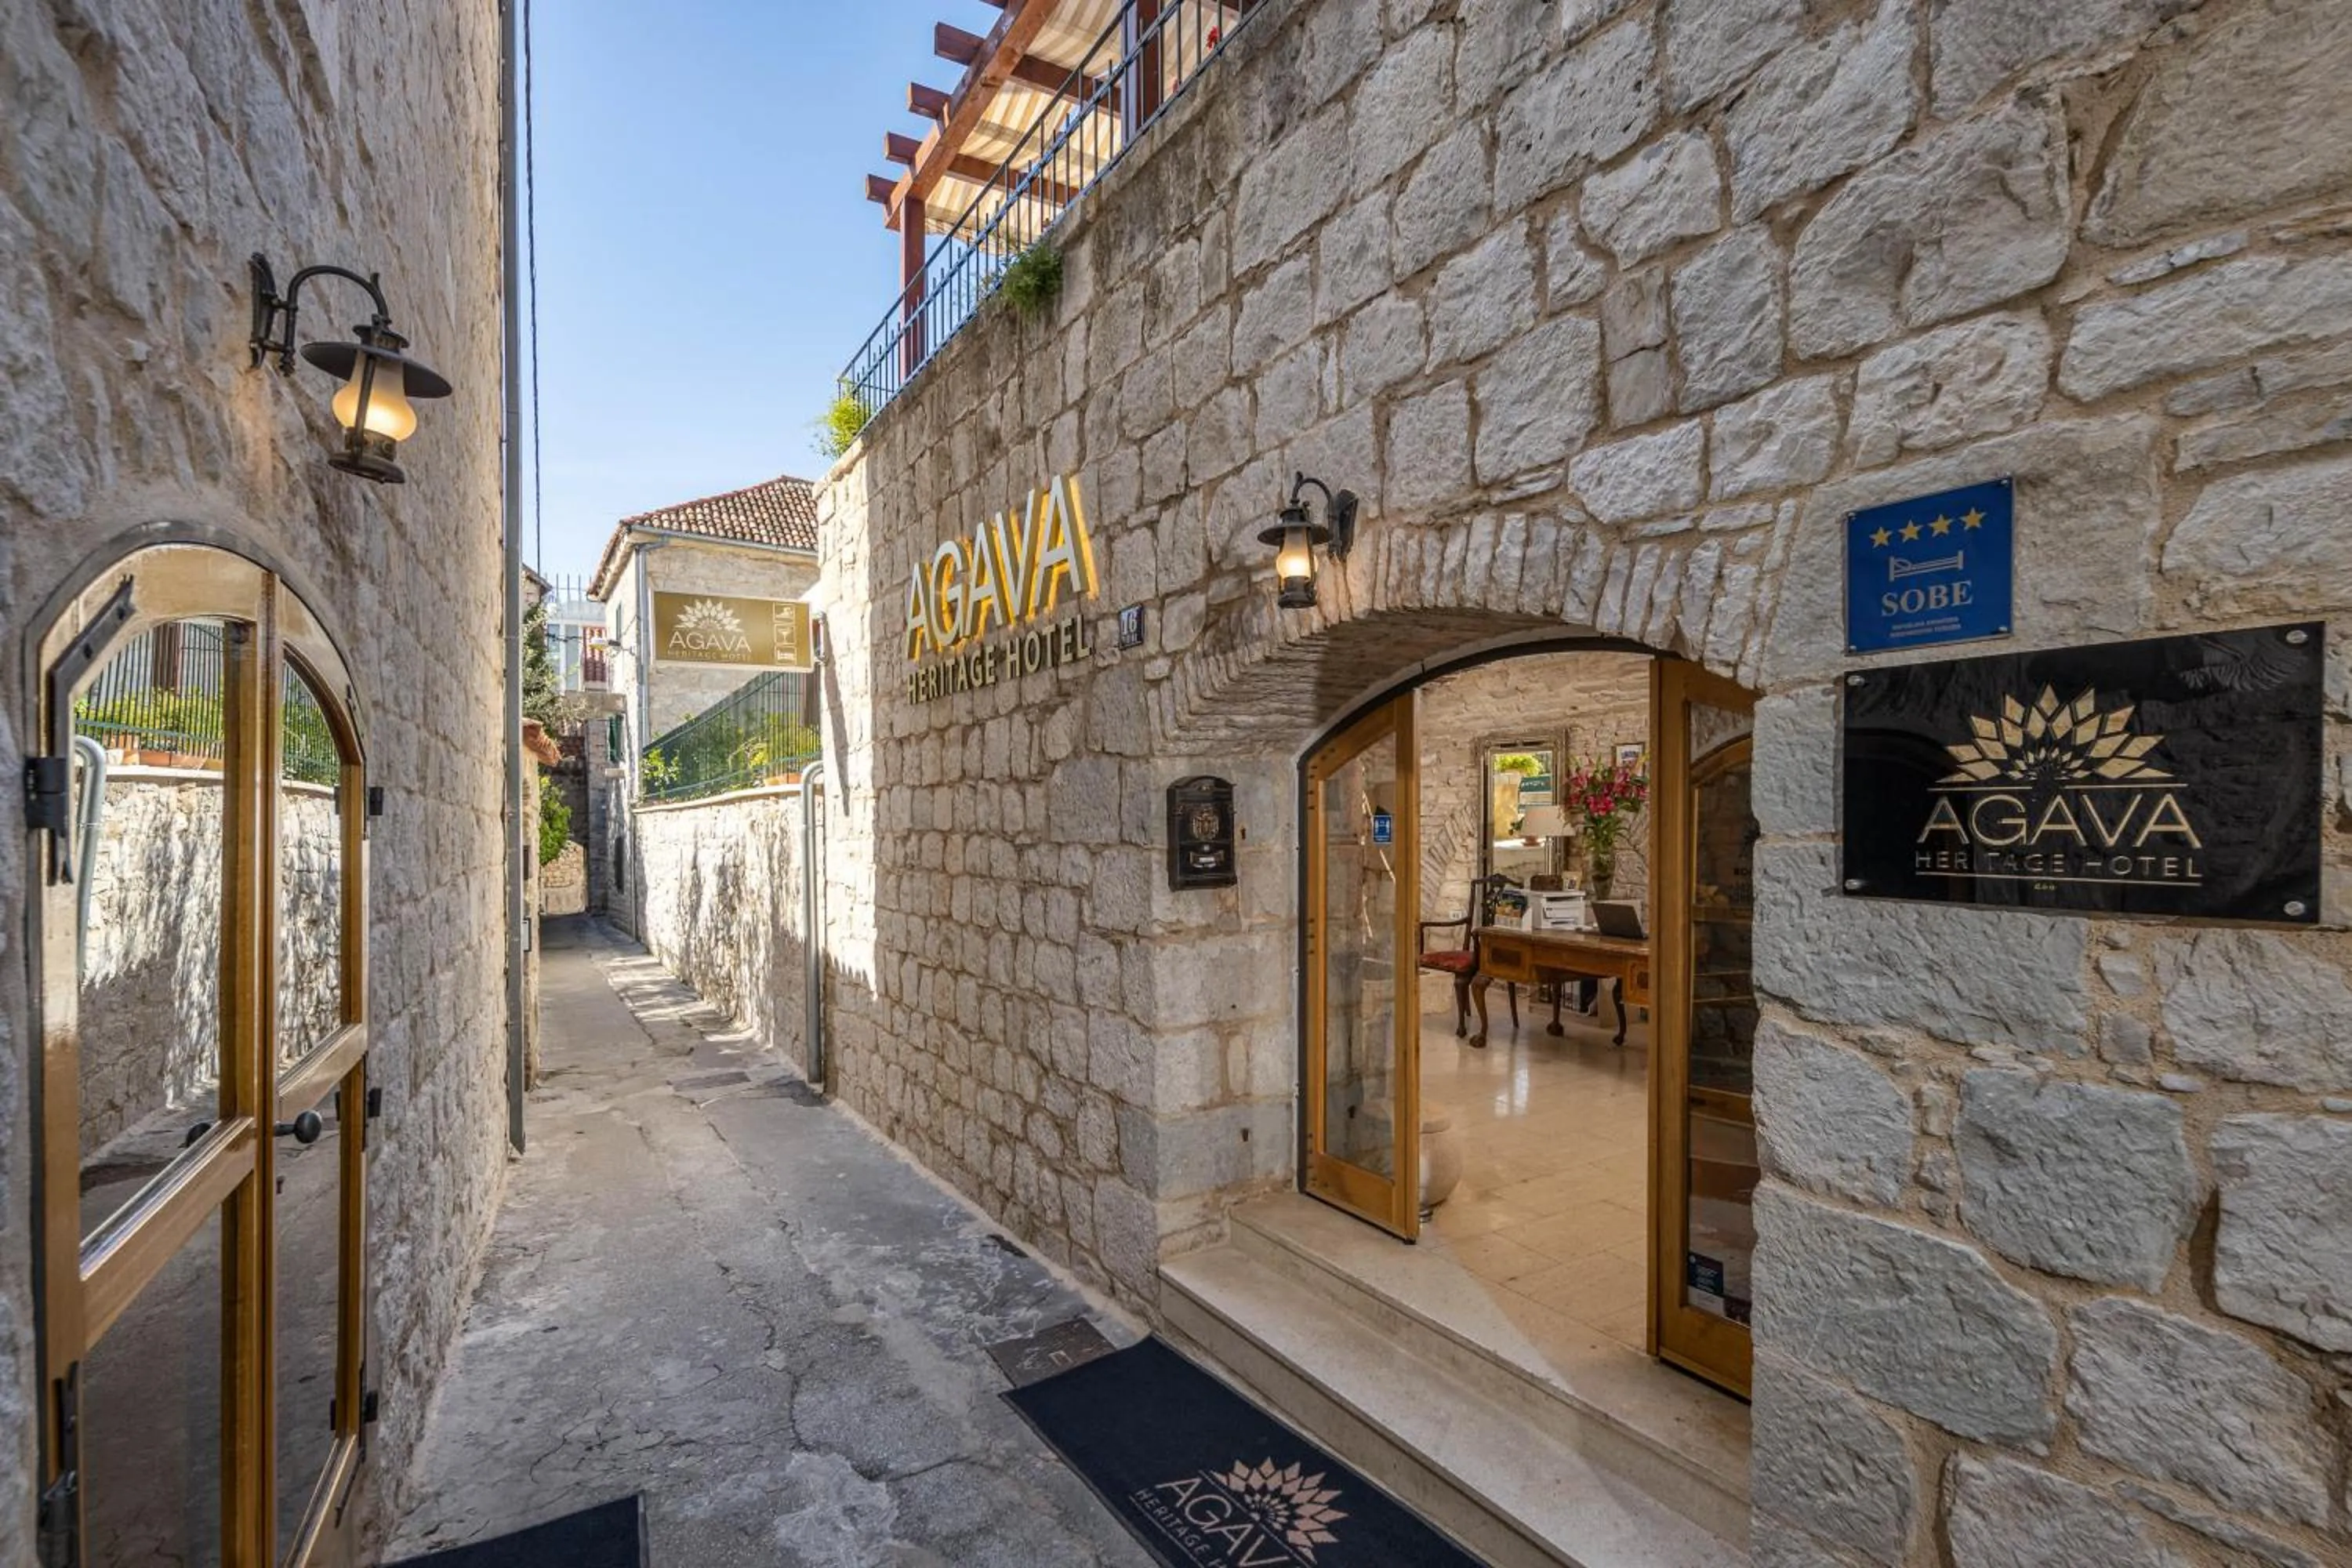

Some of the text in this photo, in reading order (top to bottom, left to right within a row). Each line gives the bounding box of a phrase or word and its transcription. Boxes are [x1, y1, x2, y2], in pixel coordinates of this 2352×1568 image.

[905, 474, 1081, 662] AGAVA
[1881, 580, 1974, 617] SOBE
[669, 630, 752, 653] AGAVA
[906, 614, 1092, 705] HERITAGE HOTEL
[1917, 793, 2203, 849] AGAVA
[1915, 850, 2203, 878] HERITAGE HOTEL
[1136, 1488, 1211, 1554] HERITAGE
[1155, 1477, 1300, 1568] AGAV
